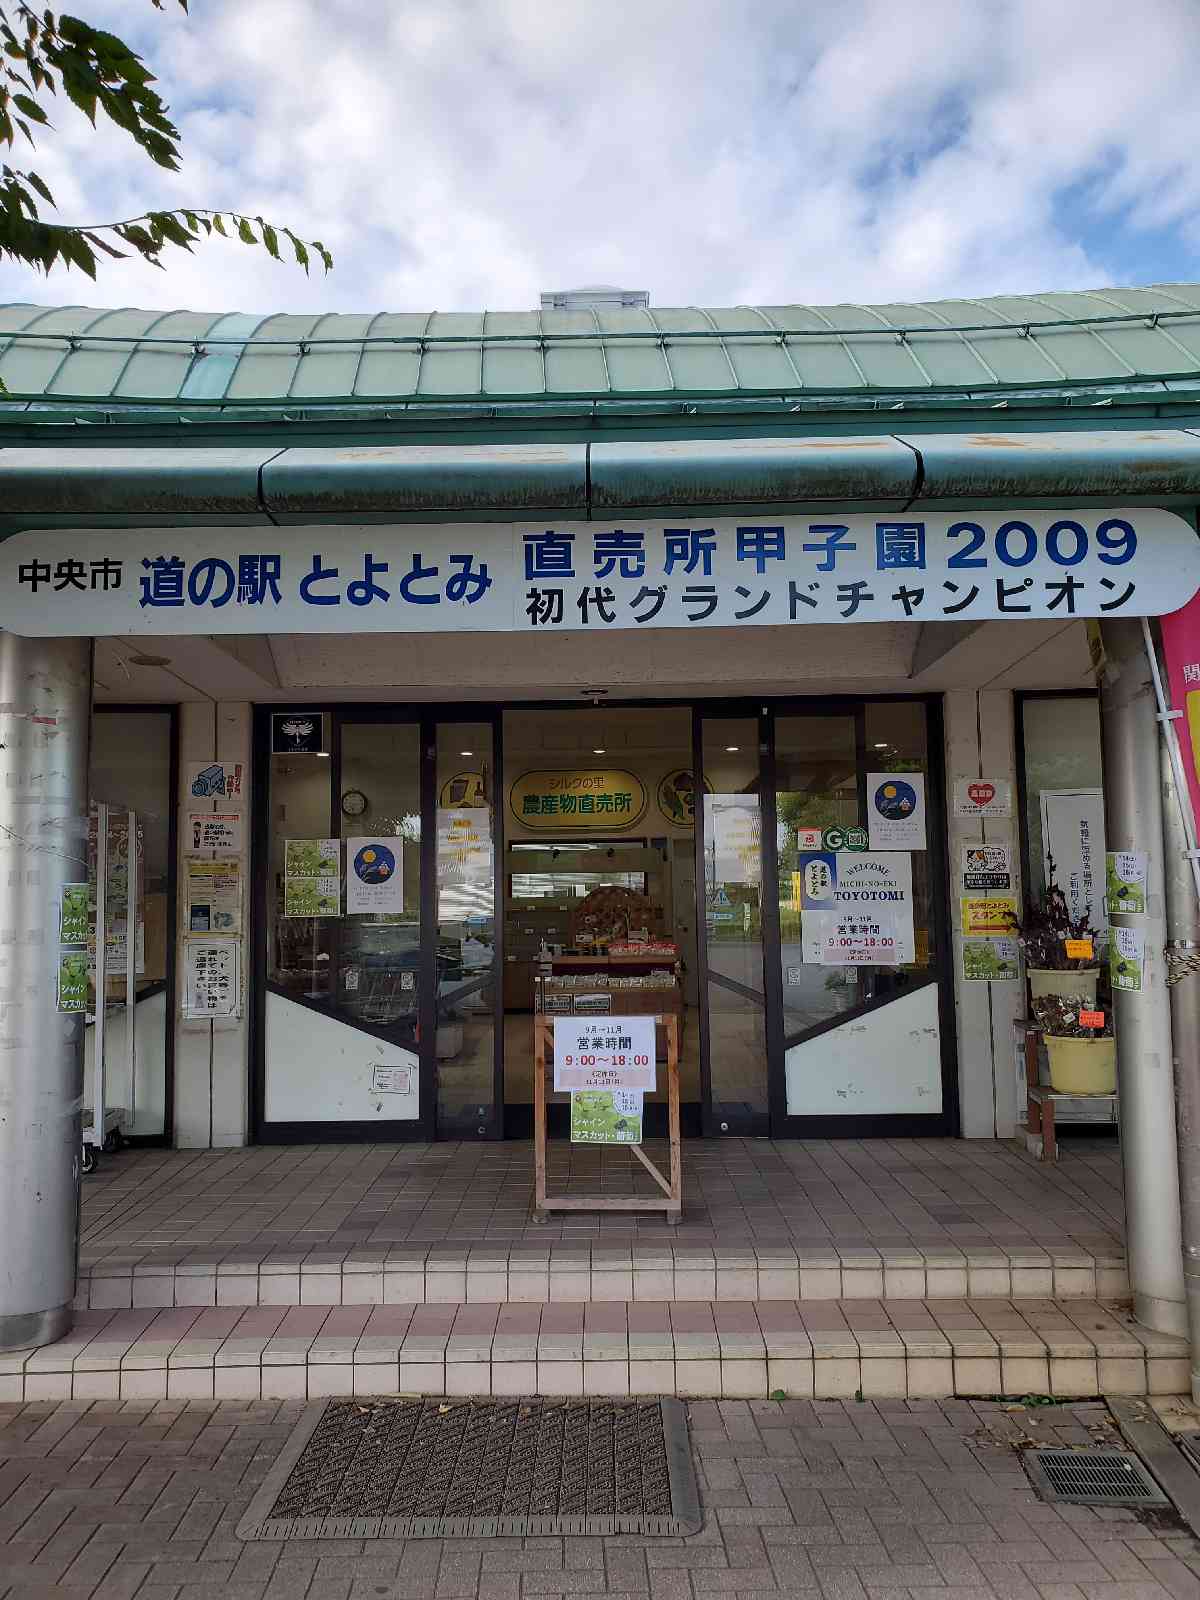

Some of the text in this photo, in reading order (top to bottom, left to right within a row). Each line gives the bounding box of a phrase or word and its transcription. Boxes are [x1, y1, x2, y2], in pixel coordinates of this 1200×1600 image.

[522, 517, 1139, 581] 直売所甲子園2009
[18, 554, 493, 608] 中央市 道の駅 とよとみ
[525, 575, 1137, 627] 初代グランドチャンピオン
[549, 776, 605, 789] シルクの里
[523, 792, 632, 815] 農産物直売所
[820, 866, 828, 887] 道の駅
[846, 862, 890, 876] WELCOME
[810, 864, 818, 896] とよとみ
[833, 890, 905, 901] TOYOTOMI
[838, 924, 880, 935] 営業時間
[577, 1036, 632, 1050] 営業時間
